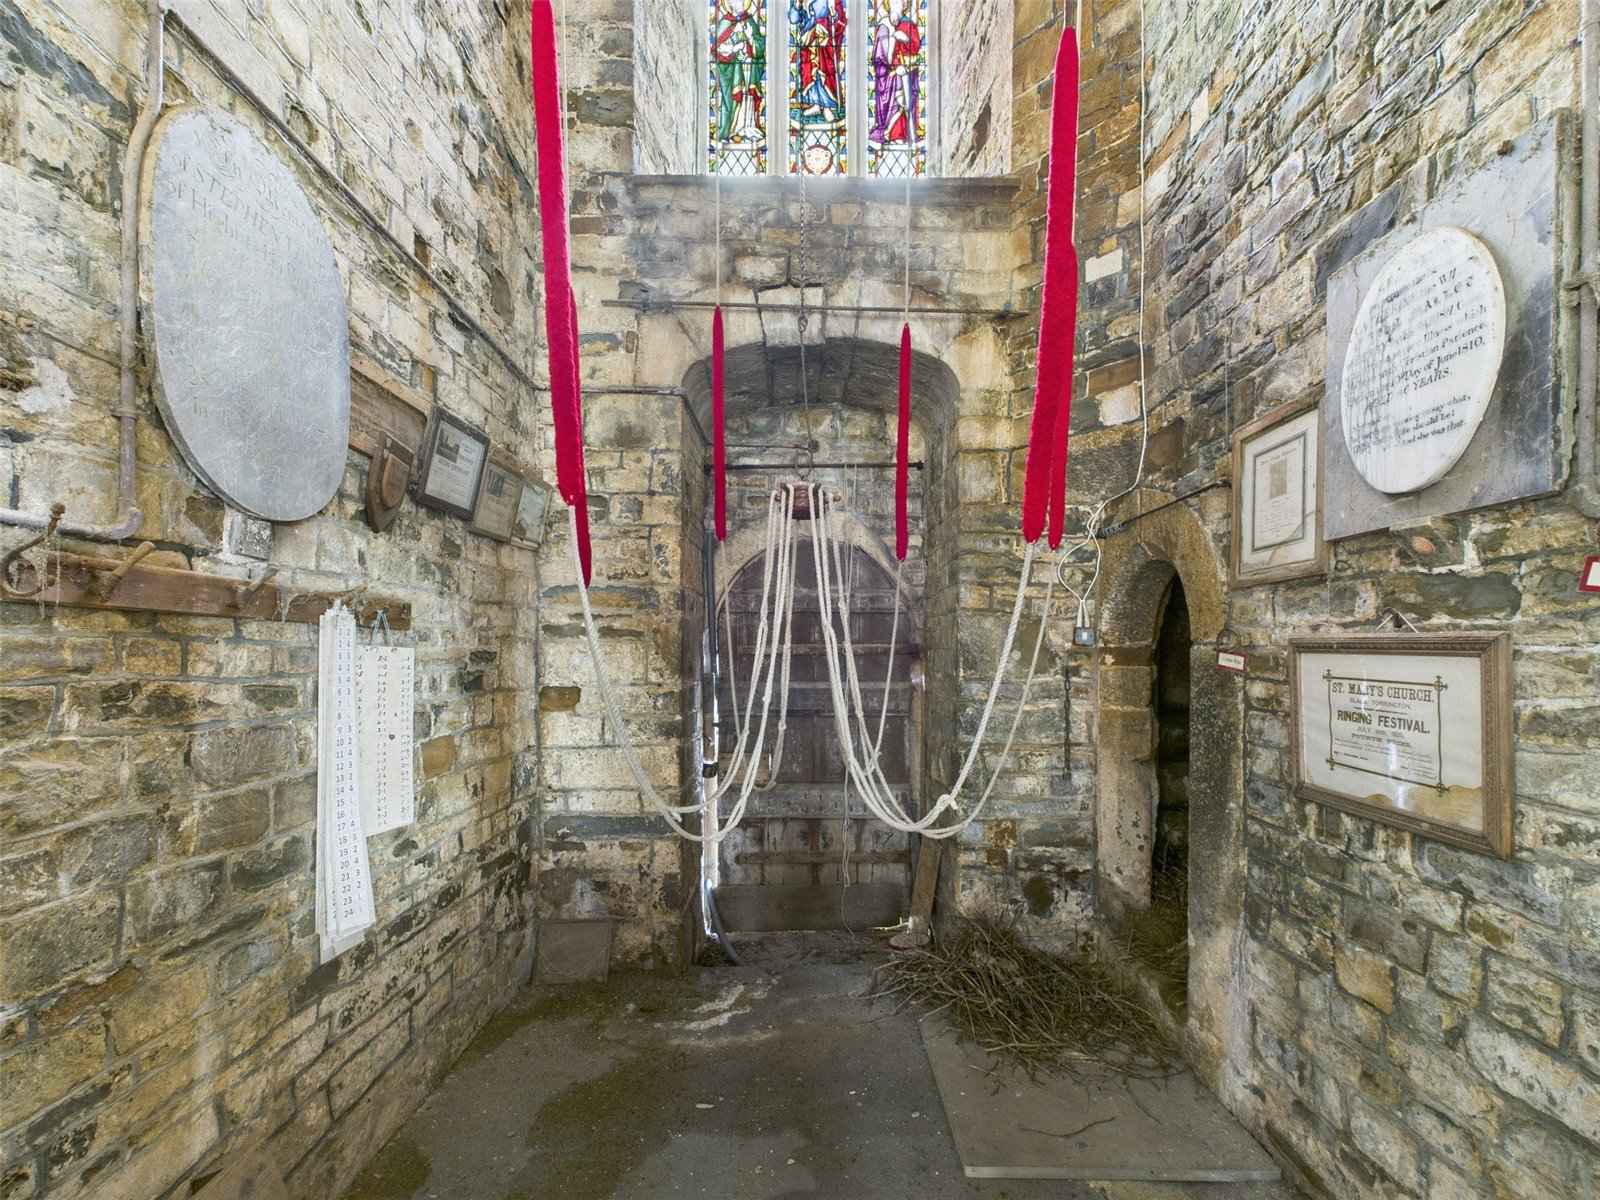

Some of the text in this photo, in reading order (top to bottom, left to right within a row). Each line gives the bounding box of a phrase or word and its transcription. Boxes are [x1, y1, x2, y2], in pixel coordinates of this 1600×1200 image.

[1423, 358, 1433, 372] of
[1434, 348, 1457, 371] June
[337, 627, 343, 637] 1
[337, 639, 343, 649] 2
[337, 651, 343, 661] 3
[337, 675, 343, 685] 5
[337, 687, 343, 697] 6
[1332, 682, 1345, 694] ST.
[337, 699, 343, 709] 7
[337, 711, 343, 721] 8
[1337, 710, 1430, 734] RINGING FESTIVAL.
[337, 725, 343, 735] 9
[336, 737, 345, 748] 10
[335, 749, 345, 760] 11
[335, 761, 345, 772] 12
[335, 773, 345, 784] 13
[335, 785, 345, 796] 14
[336, 797, 346, 808] 15
[336, 809, 346, 820] 16
[337, 821, 346, 832] 17
[338, 835, 348, 846] 18
[339, 847, 349, 858] 19
[340, 859, 350, 871] 20
[340, 871, 351, 882] 21
[342, 883, 352, 895] 22
[343, 895, 353, 907] 23
[343, 907, 354, 919] 24
